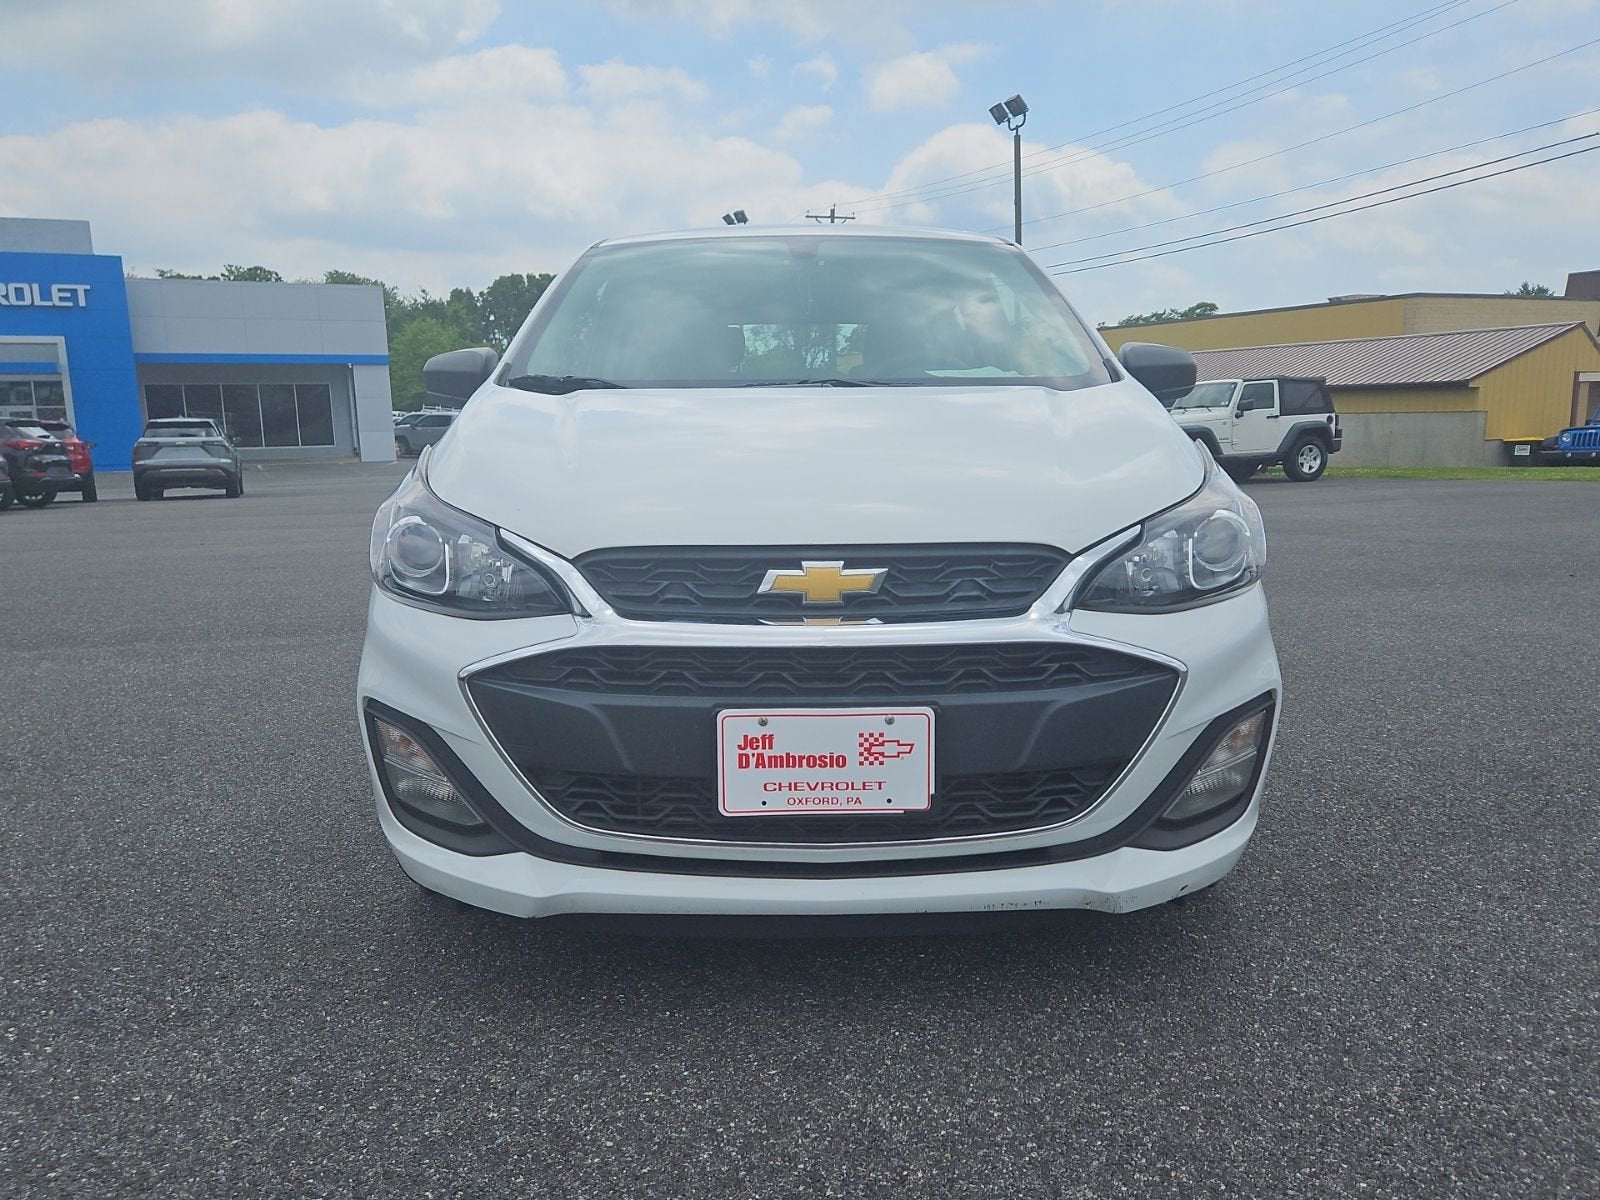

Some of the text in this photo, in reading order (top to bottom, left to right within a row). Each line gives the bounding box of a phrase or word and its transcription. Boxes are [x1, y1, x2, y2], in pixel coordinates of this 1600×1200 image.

[737, 733, 775, 750] Jeff
[738, 752, 847, 769] D'Ambrosio
[763, 781, 887, 792] CHEVROLET
[787, 796, 863, 806] OXFORD, PA
